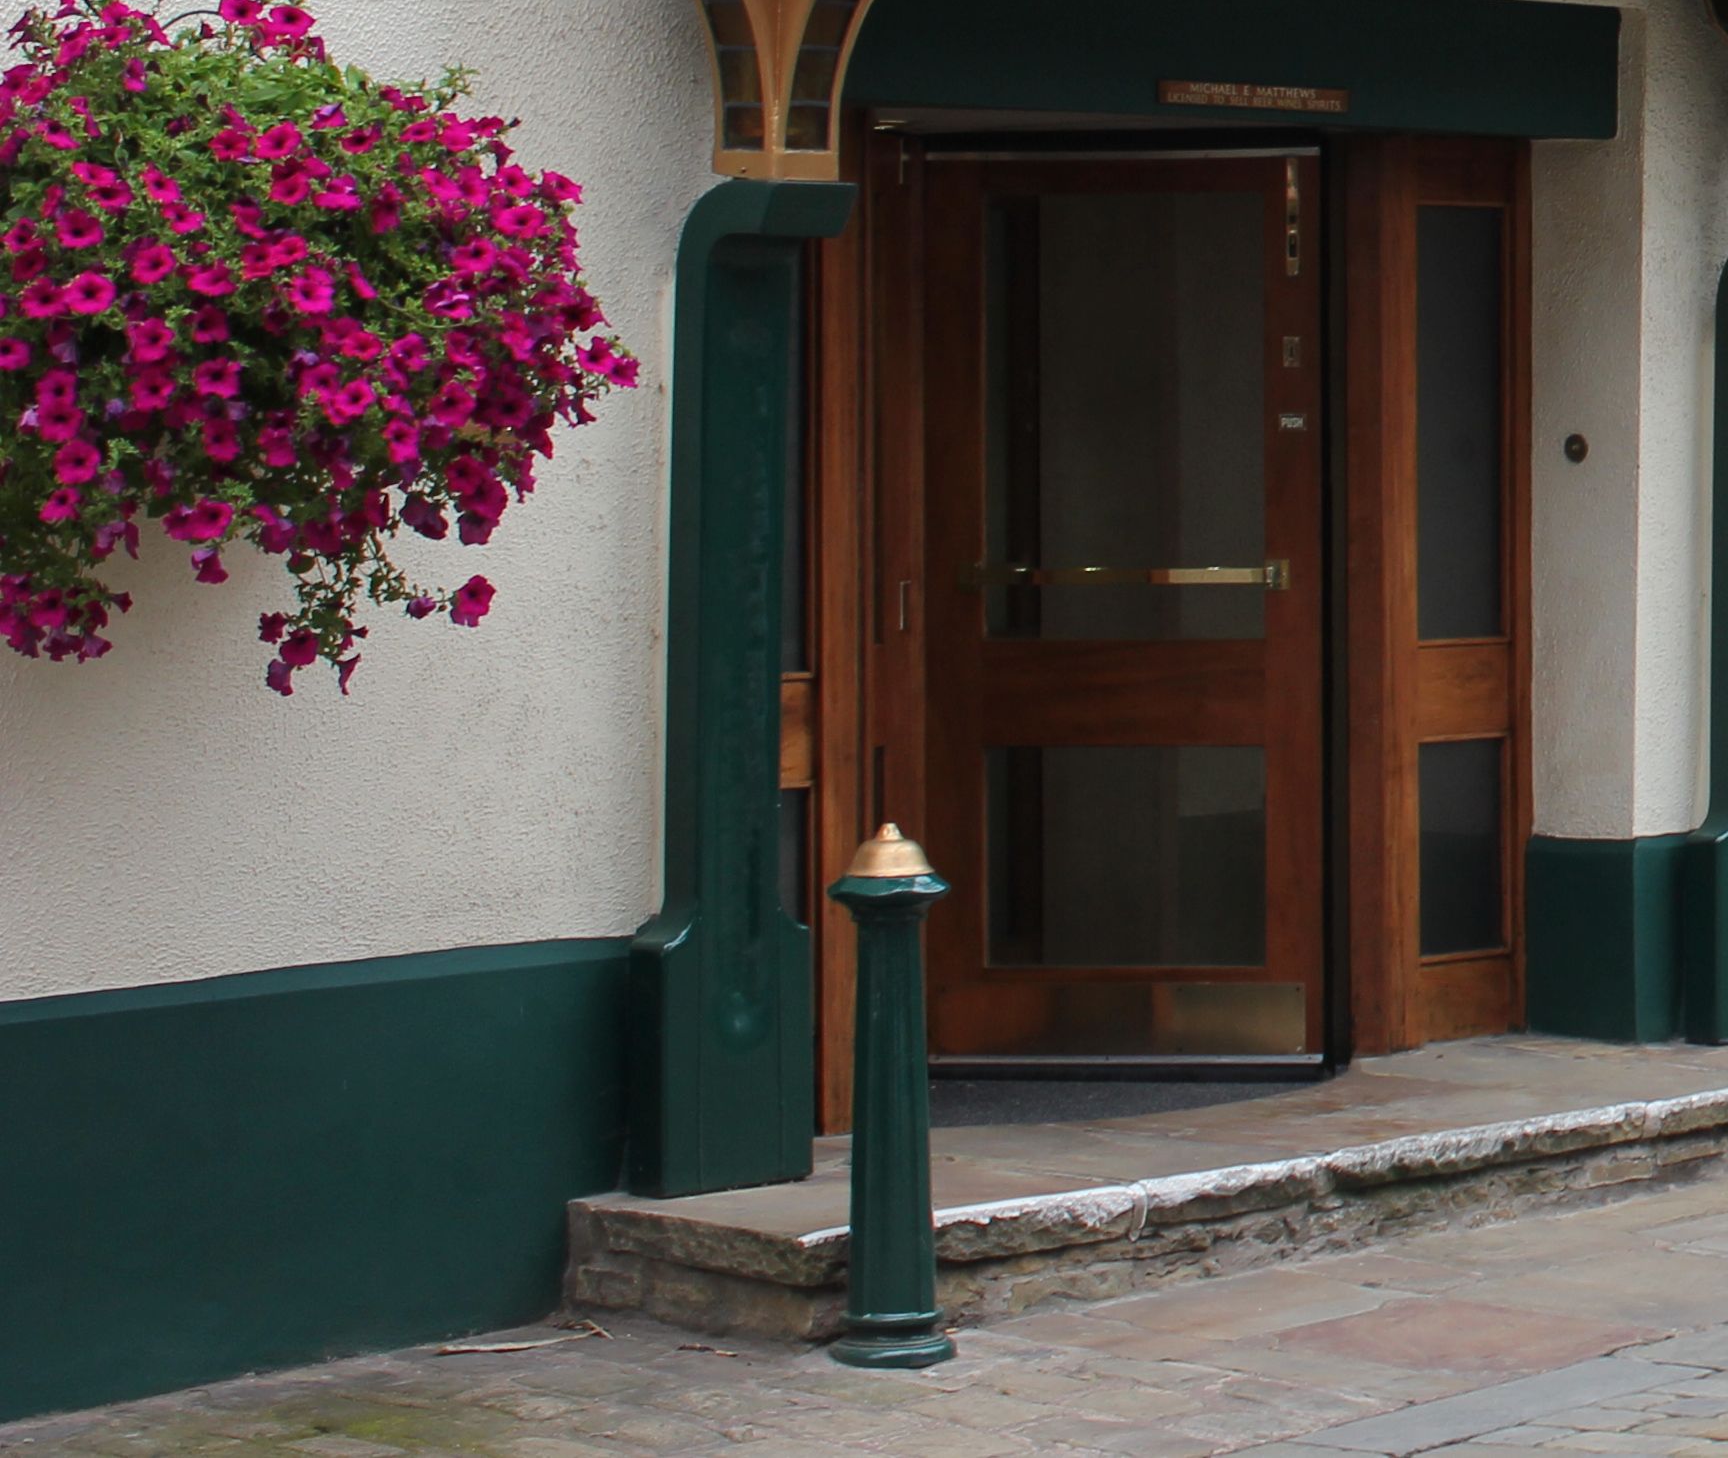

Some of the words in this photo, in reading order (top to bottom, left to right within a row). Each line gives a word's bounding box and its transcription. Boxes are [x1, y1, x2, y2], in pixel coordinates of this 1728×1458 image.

[1190, 82, 1237, 95] MICHAEL
[1243, 85, 1251, 96] E
[1256, 86, 1317, 99] MATTHEWS
[1213, 94, 1226, 105] TO
[1281, 417, 1303, 429] PUSH
